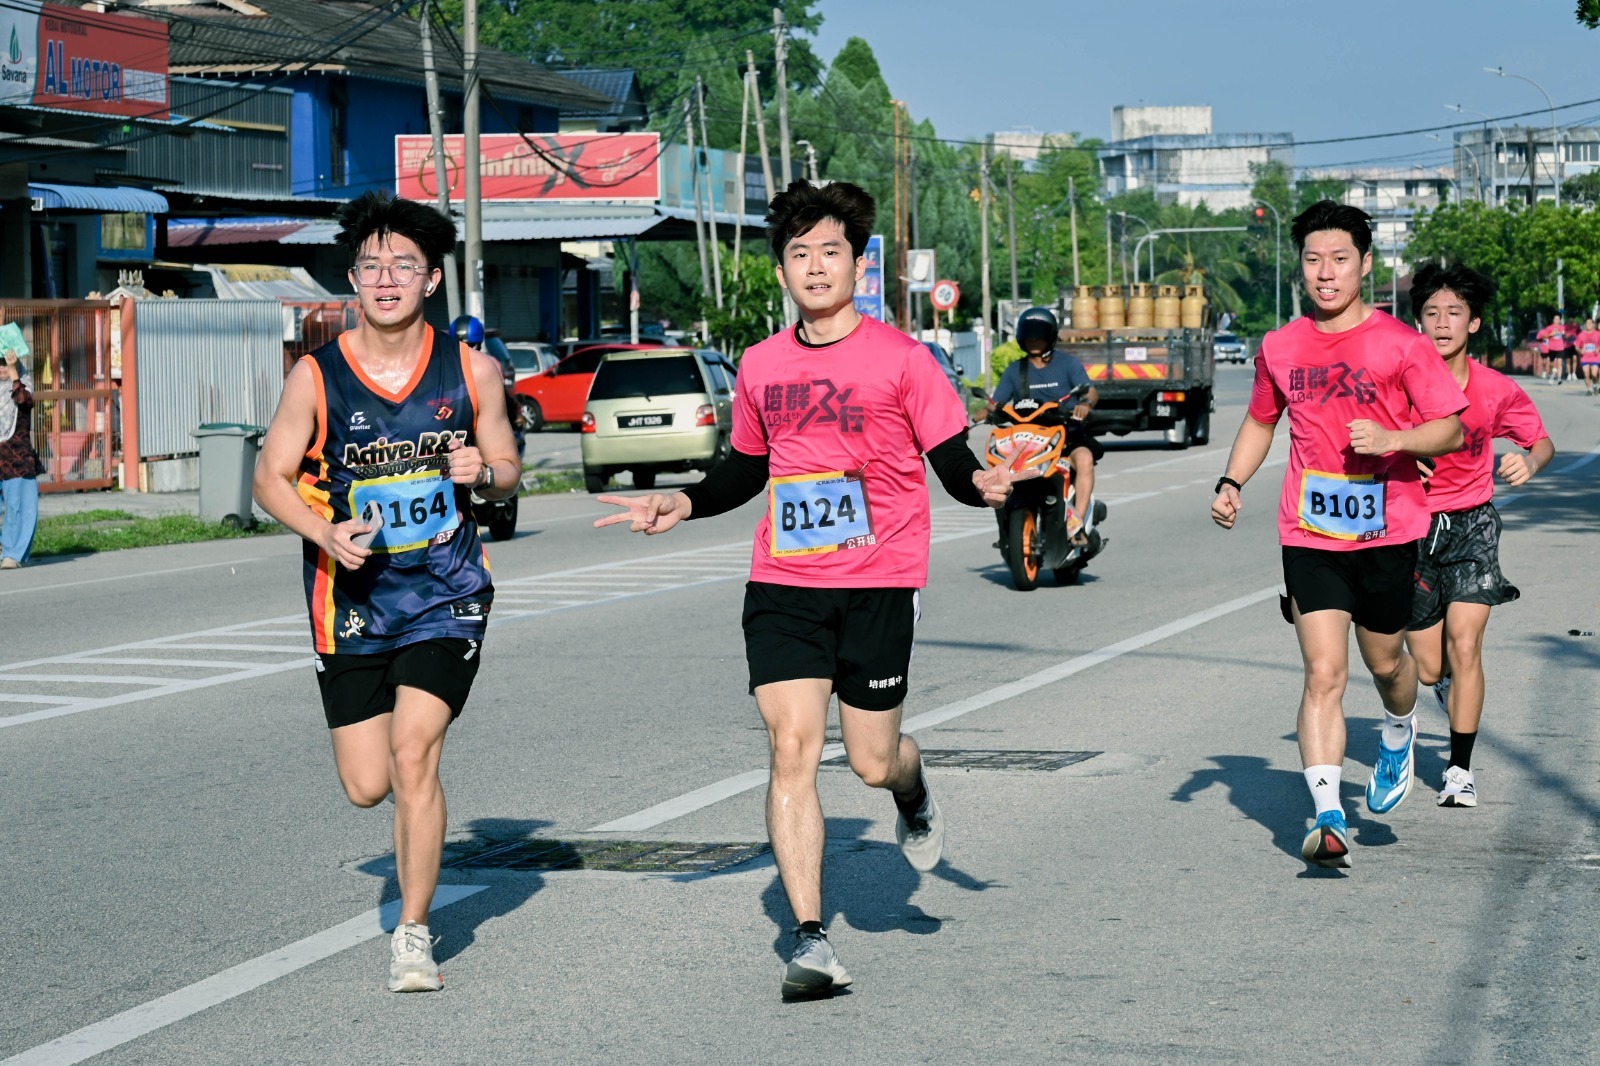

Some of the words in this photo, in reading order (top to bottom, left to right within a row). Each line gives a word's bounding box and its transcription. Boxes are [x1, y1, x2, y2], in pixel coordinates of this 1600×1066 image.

[1, 65, 27, 83] Savana
[44, 39, 69, 96] AL
[71, 57, 122, 103] MOTOR
[766, 412, 802, 427] 104th
[343, 436, 415, 466] Active
[379, 460, 405, 475] with
[365, 491, 448, 529] 164
[781, 494, 857, 532] B124
[1310, 491, 1376, 520] B103
[846, 534, 876, 549] 公开组
